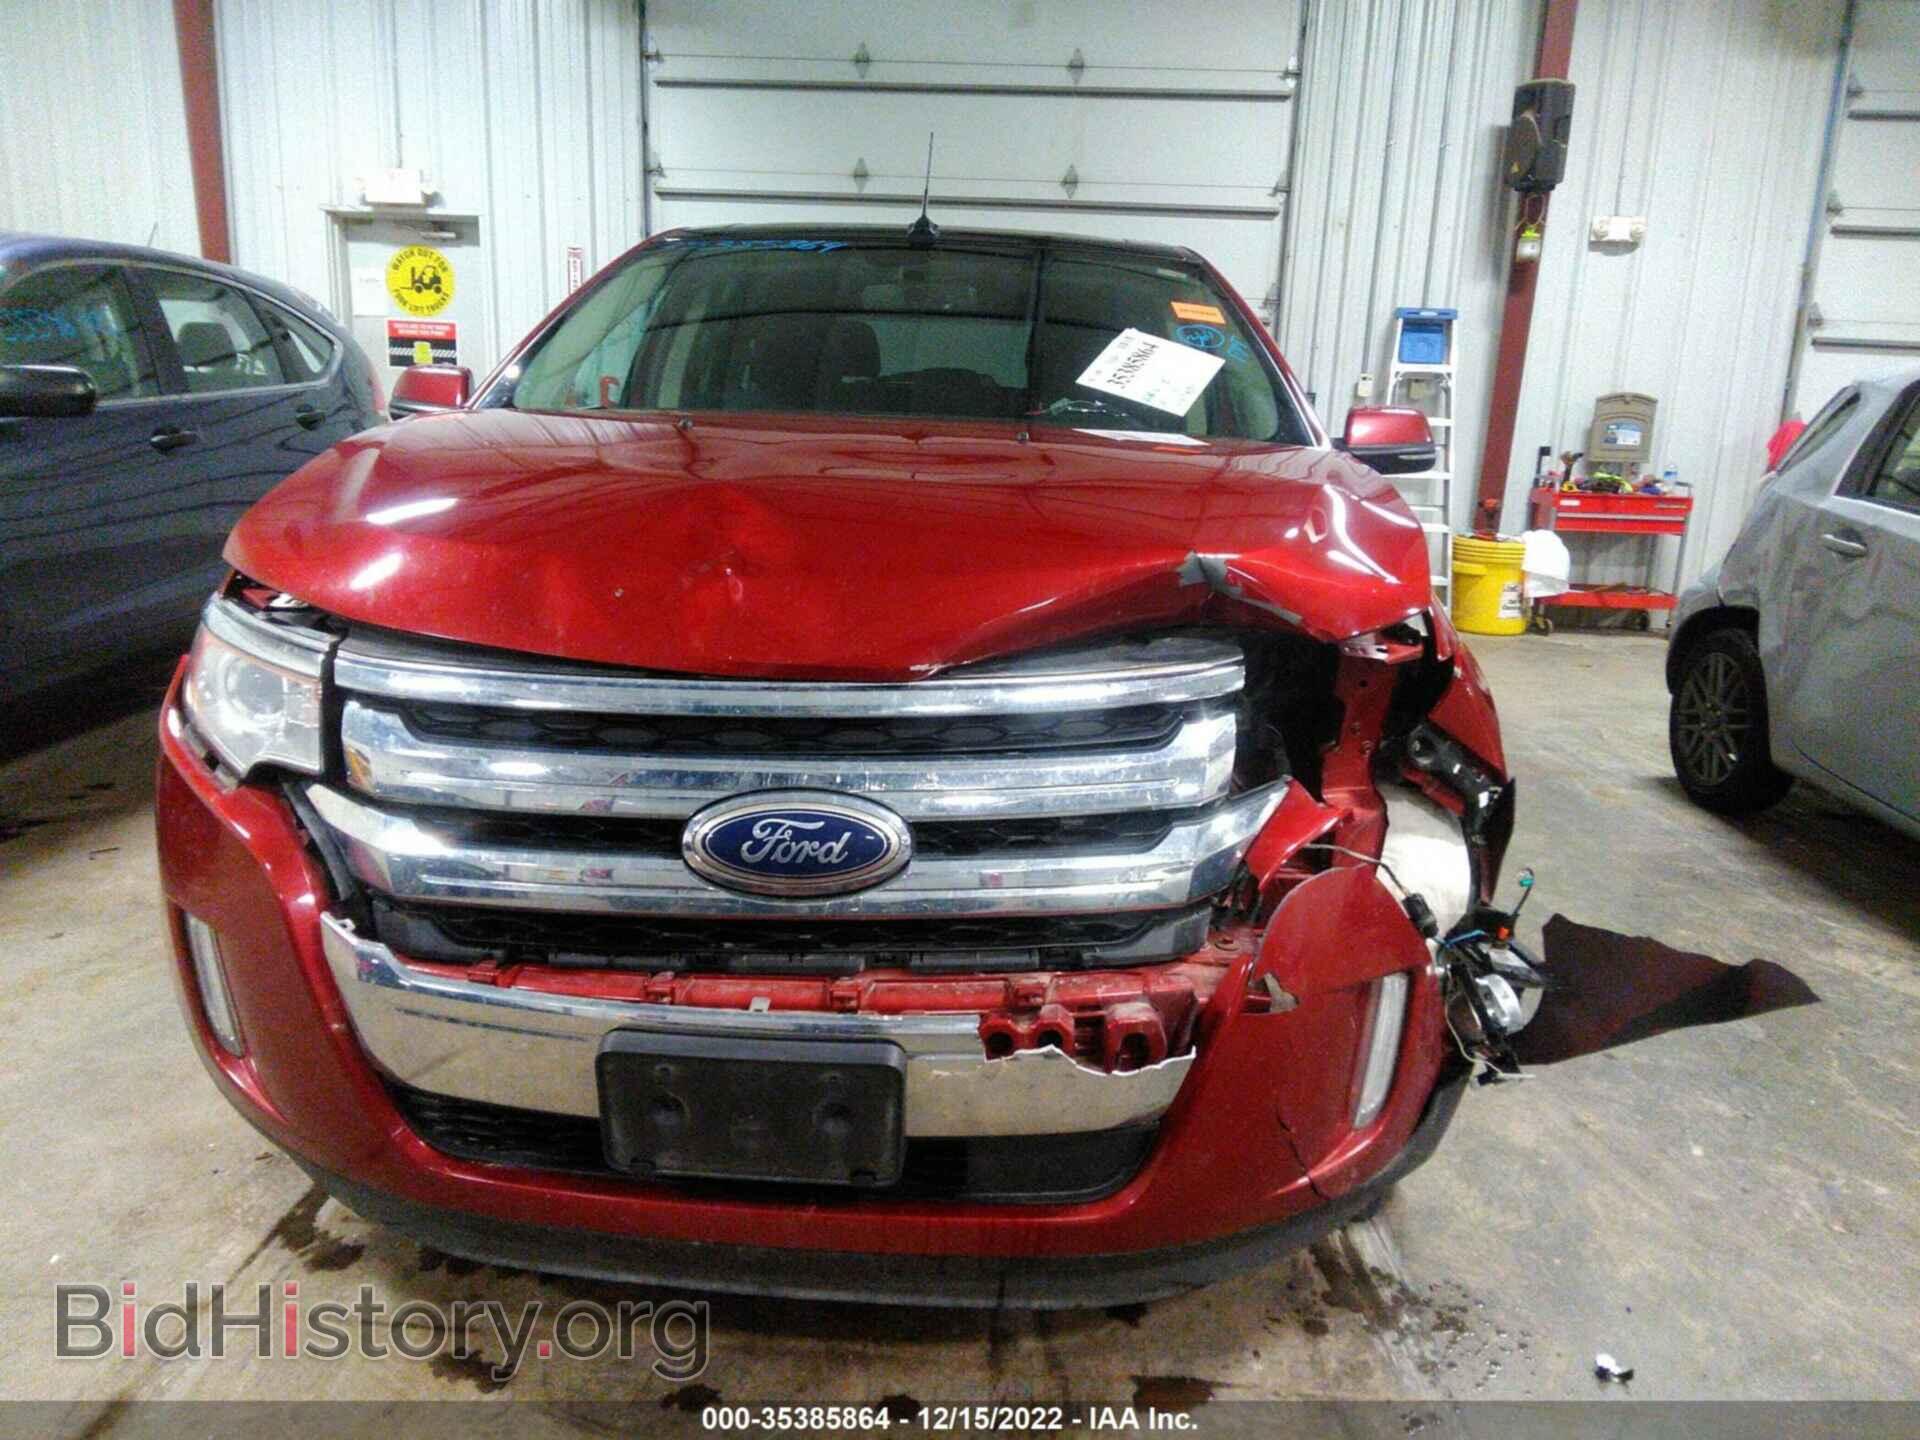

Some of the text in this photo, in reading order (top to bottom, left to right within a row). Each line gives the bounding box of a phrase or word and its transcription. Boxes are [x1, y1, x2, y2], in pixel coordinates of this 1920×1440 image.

[417, 246, 434, 259] OUT
[1106, 341, 1161, 389] 35385864
[741, 817, 852, 864] Ford
